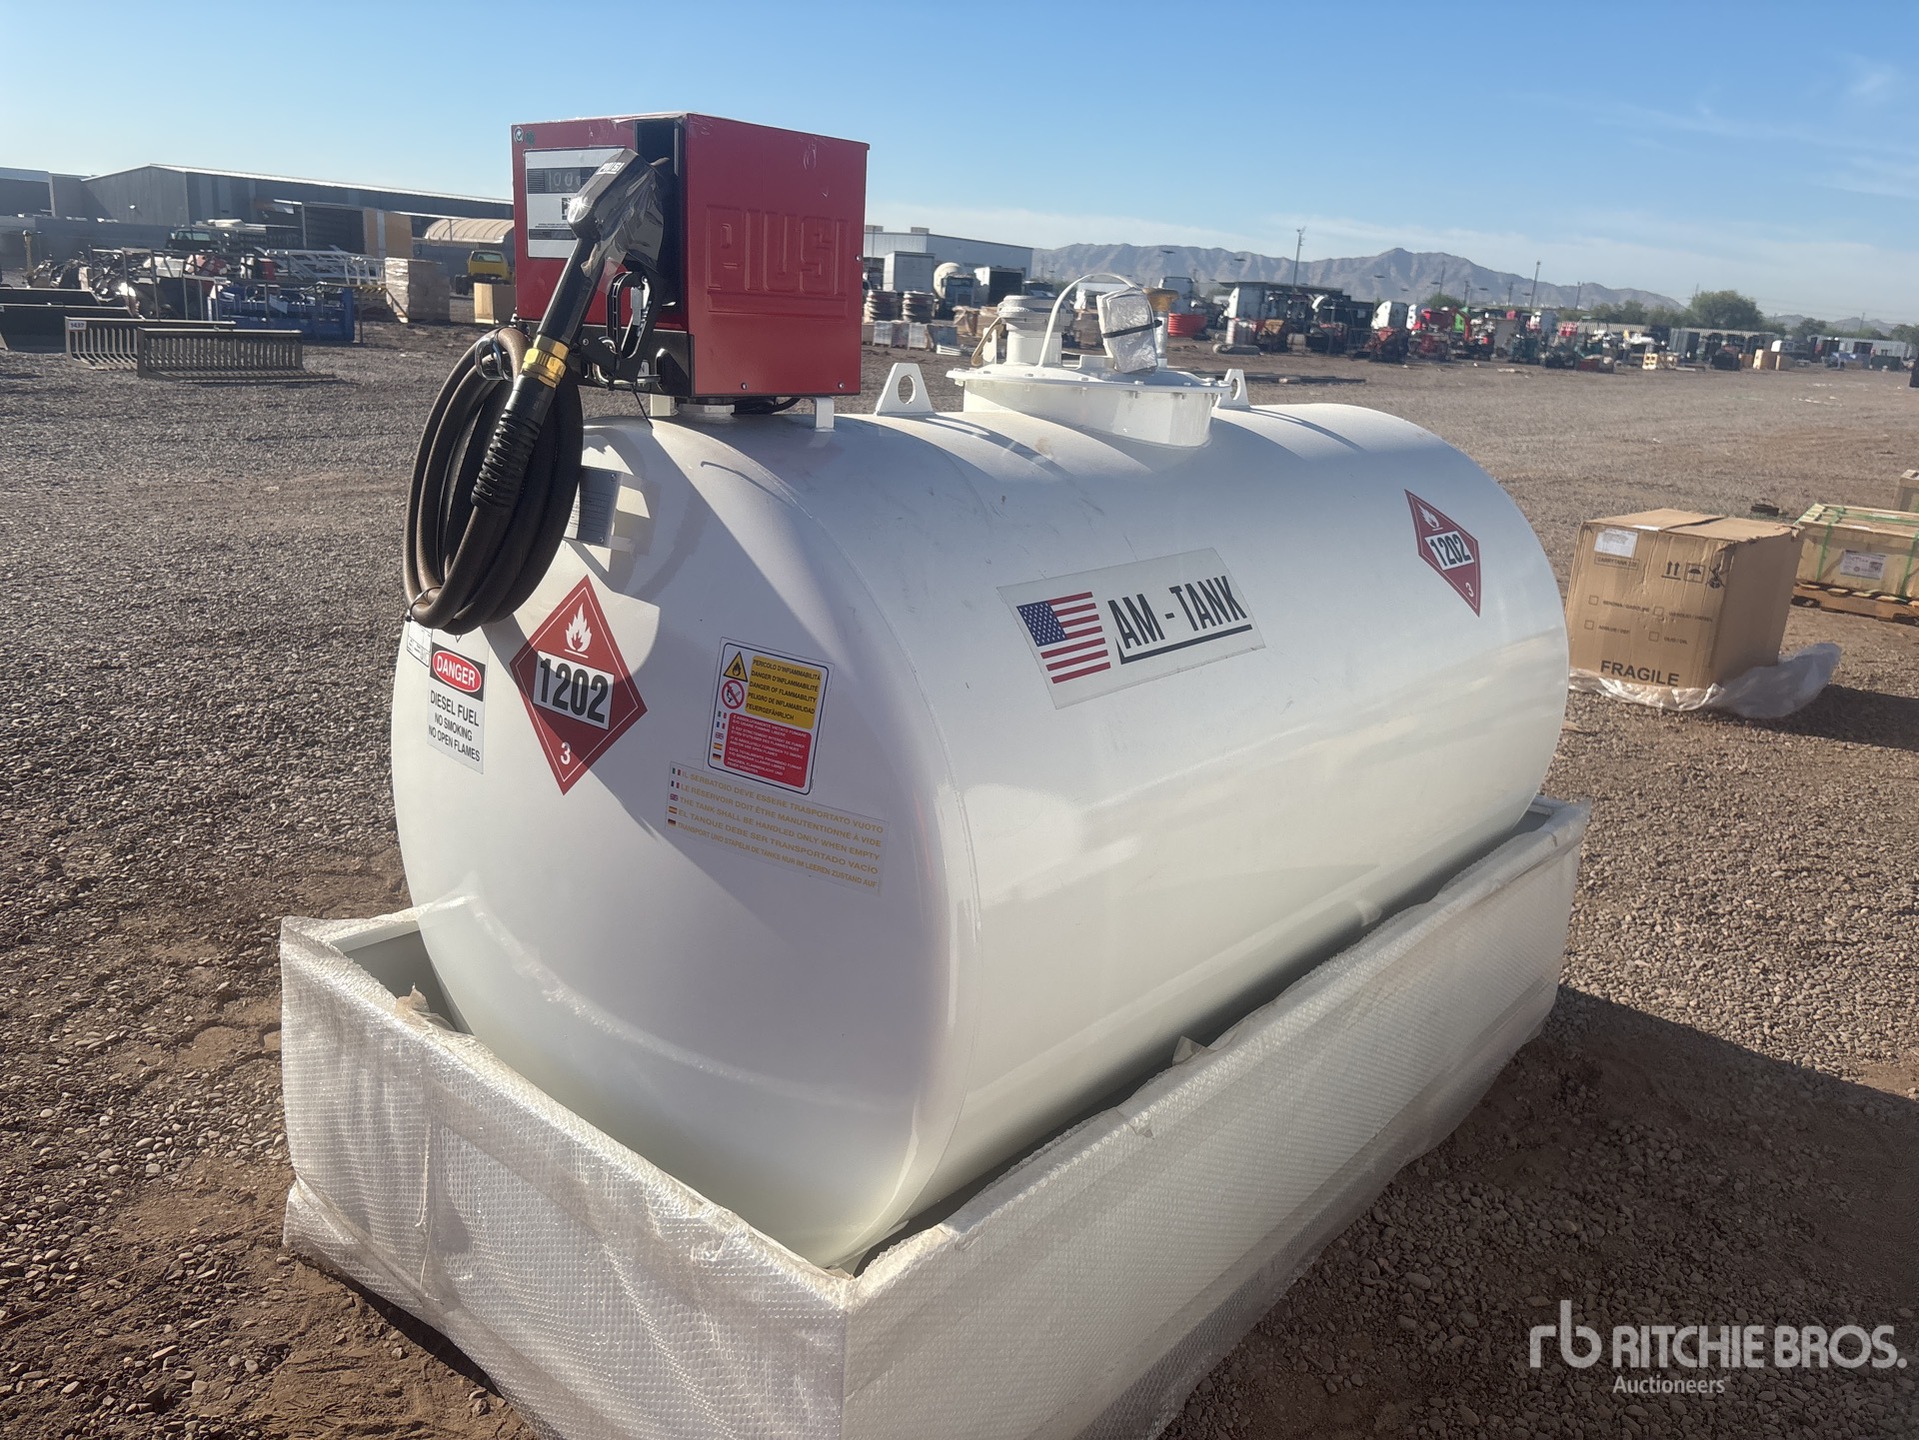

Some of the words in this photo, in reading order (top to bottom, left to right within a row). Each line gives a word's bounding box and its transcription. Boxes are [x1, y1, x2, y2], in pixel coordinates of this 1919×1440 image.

[1430, 534, 1471, 567] 1202
[1465, 582, 1474, 597] 3
[1108, 593, 1165, 649] AM
[1169, 575, 1247, 631] TANK
[436, 655, 476, 688] DANGER
[751, 670, 771, 679] DANGER
[752, 659, 776, 670] PERICOLO
[1600, 660, 1680, 687] FRAGILE
[541, 658, 609, 724] 1202
[747, 692, 767, 702] PELIGRO
[749, 681, 770, 691] DANGER
[778, 688, 816, 702] FLAMMABILITY
[430, 690, 455, 716] DIESEL
[457, 704, 479, 727] FUEL
[429, 725, 437, 738] NO
[438, 730, 453, 748] OPEN
[454, 739, 481, 762] FLAMES
[434, 713, 443, 726] NO
[444, 717, 472, 741] SMOKING
[560, 742, 571, 765] 3
[681, 784, 690, 793] LE
[735, 800, 754, 812] DOIT
[853, 833, 859, 842] À
[861, 835, 881, 848] VIDE
[733, 786, 753, 798] DEVE
[756, 793, 787, 808] ESSERE
[790, 802, 850, 825] TRASPORTATO
[853, 819, 883, 834] VUOTO
[678, 809, 688, 818] EL
[691, 813, 723, 829] TANQUE
[725, 824, 748, 837] DEBE
[750, 832, 768, 843] SER
[770, 837, 845, 866] TRANSPORTADO
[680, 797, 694, 806] THE
[695, 801, 715, 813] TANK
[717, 808, 741, 821] SHALL
[743, 816, 754, 825] BE
[755, 820, 794, 837] HANDLED
[797, 831, 820, 844] ONLY
[820, 838, 847, 852] WHEN
[849, 846, 879, 861] EMPTY
[678, 822, 710, 838] TRANSPORT
[711, 832, 723, 842] UND
[782, 855, 795, 864] NUR
[831, 869, 861, 884] ZUSTAND
[863, 879, 877, 888] AUF
